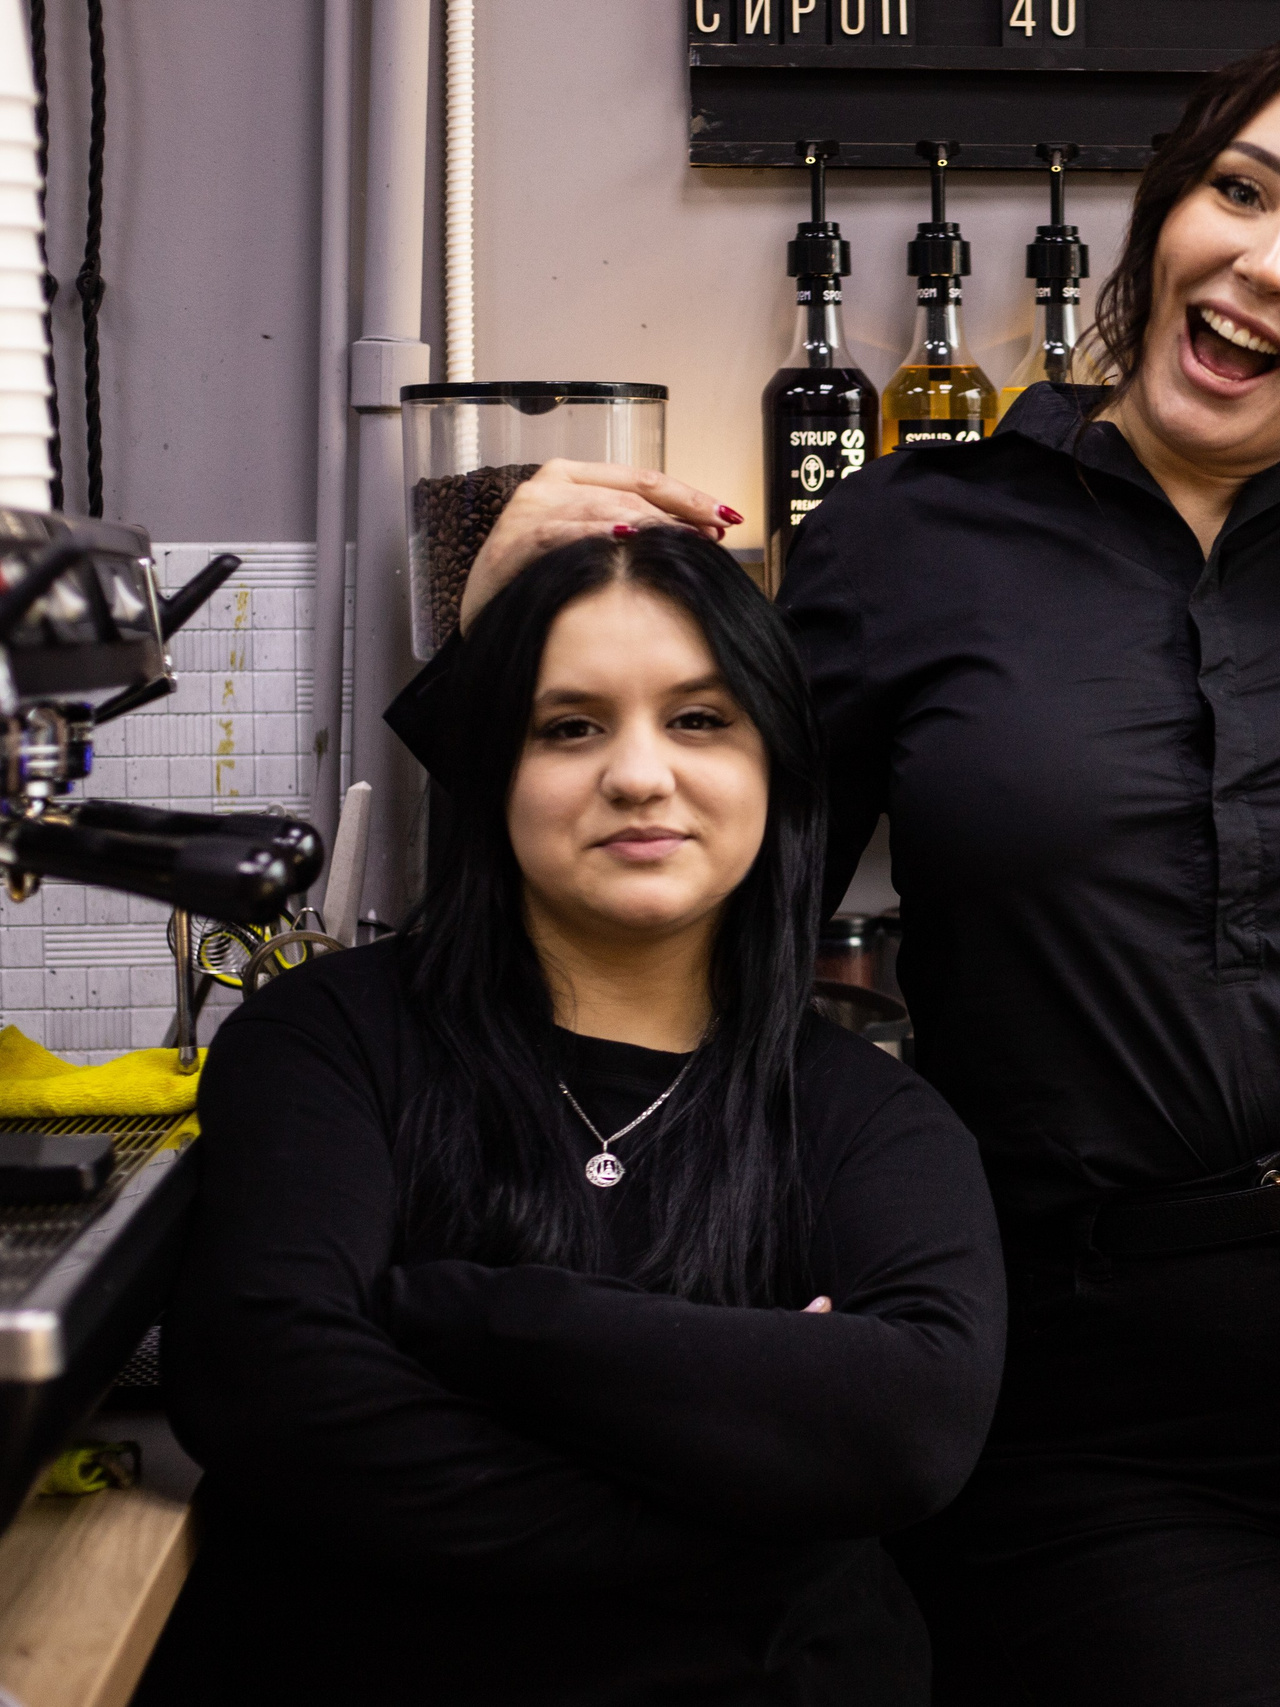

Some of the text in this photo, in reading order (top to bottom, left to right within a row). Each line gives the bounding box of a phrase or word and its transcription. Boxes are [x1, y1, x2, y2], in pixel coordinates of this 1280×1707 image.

[695, 0, 1077, 37] СИРОП 40
[790, 431, 838, 447] SYRUP
